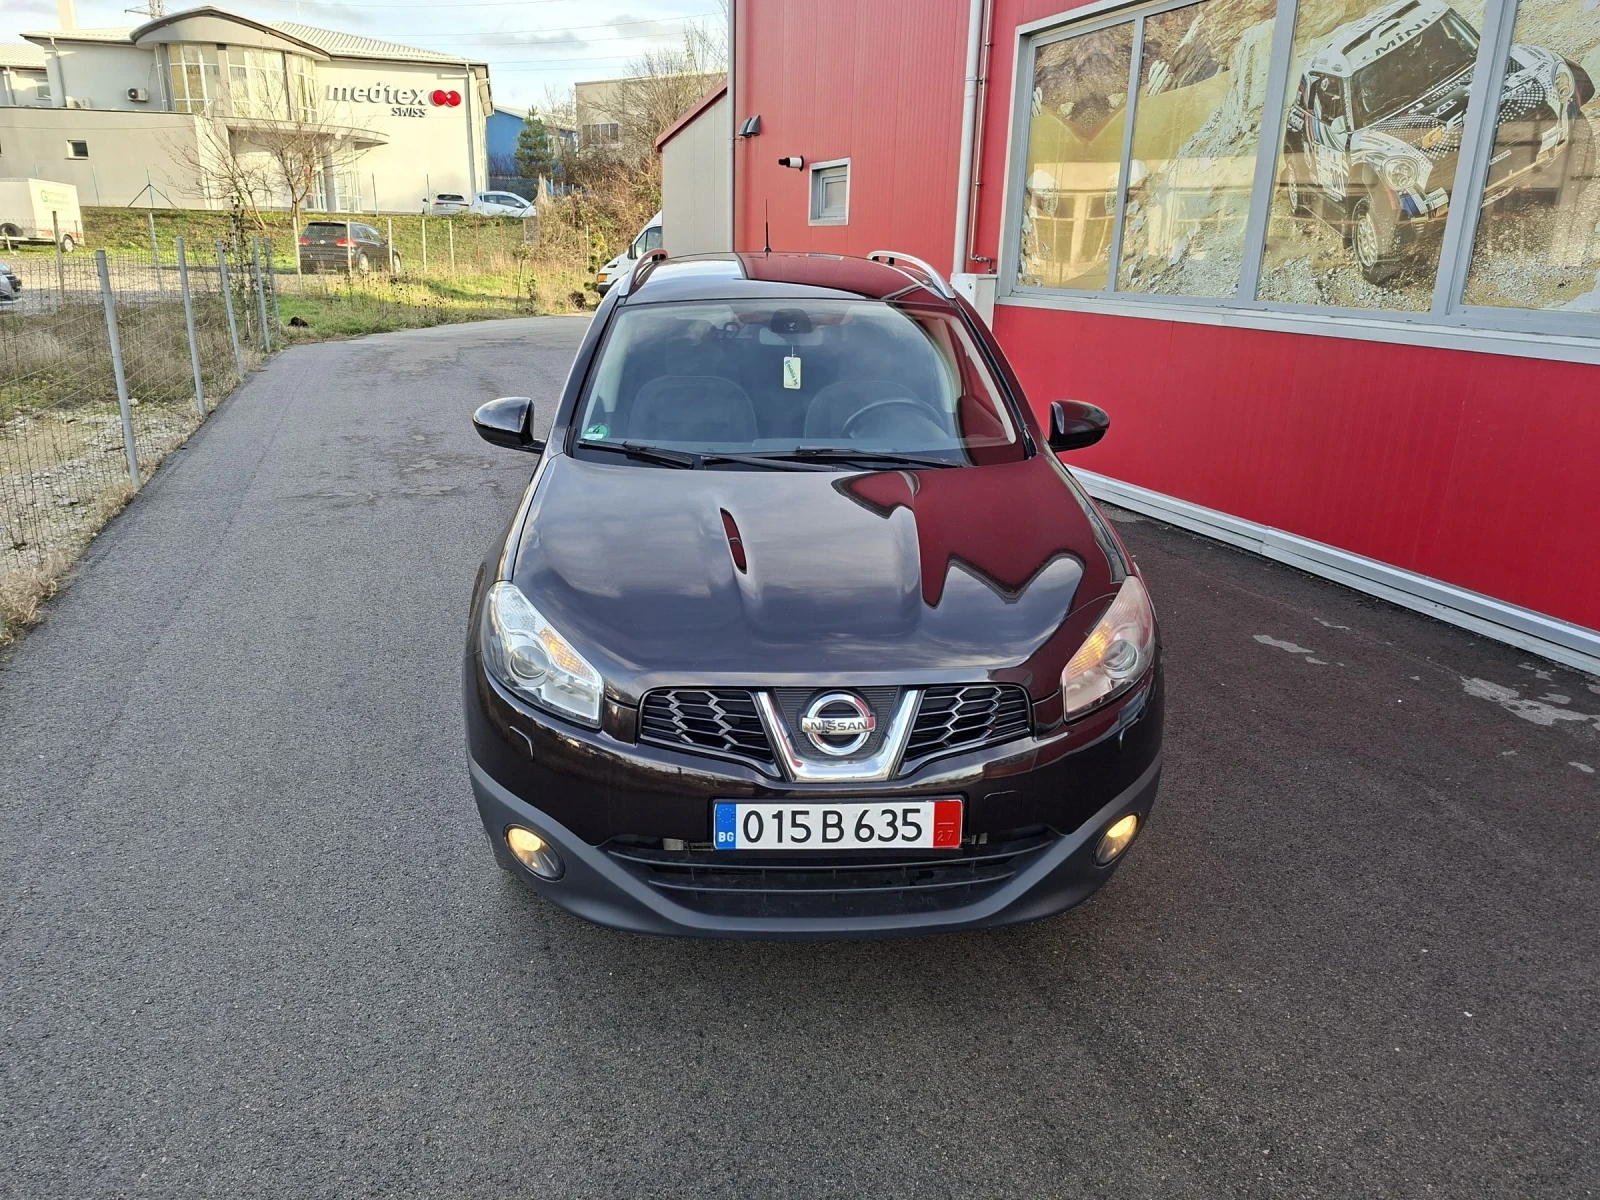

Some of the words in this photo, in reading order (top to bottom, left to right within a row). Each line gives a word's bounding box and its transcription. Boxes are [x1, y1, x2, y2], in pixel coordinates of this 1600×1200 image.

[324, 81, 429, 106] medtex
[391, 106, 428, 118] SWISS
[810, 721, 868, 732] NISSAN
[718, 831, 735, 843] BG
